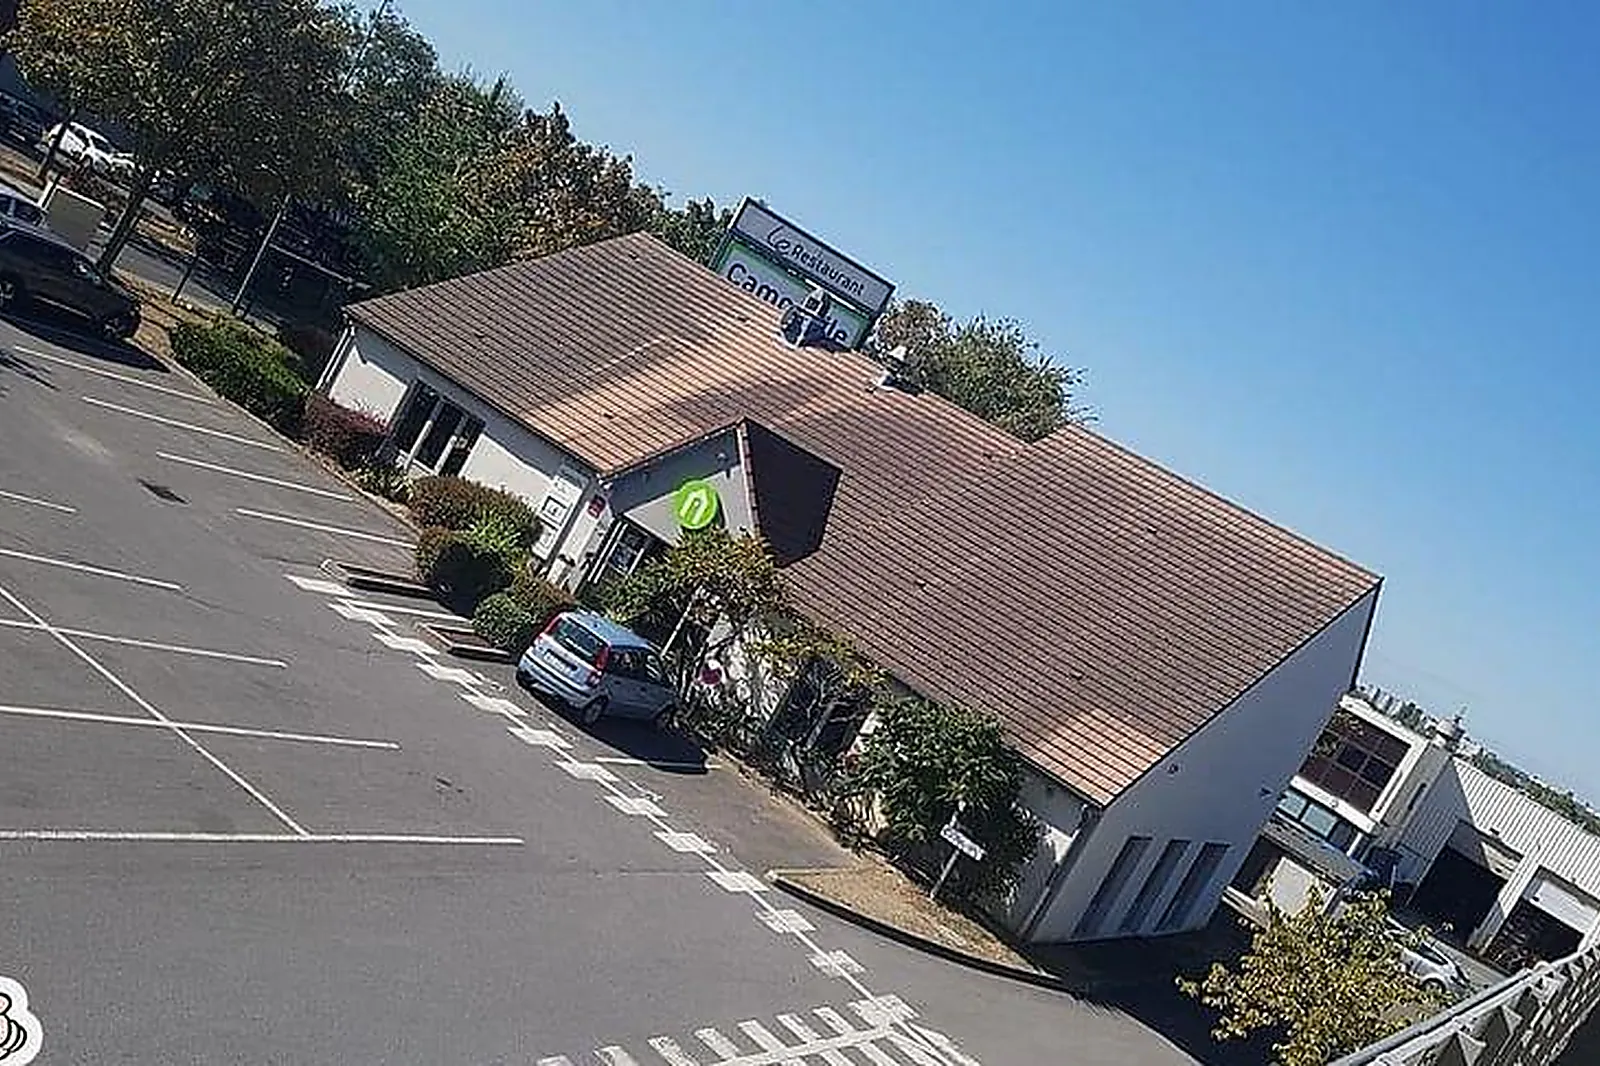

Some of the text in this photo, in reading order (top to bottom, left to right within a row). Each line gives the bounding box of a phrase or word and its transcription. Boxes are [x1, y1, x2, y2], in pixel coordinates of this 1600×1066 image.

[767, 226, 865, 296] Le Restaurant
[727, 262, 848, 342] Camle
